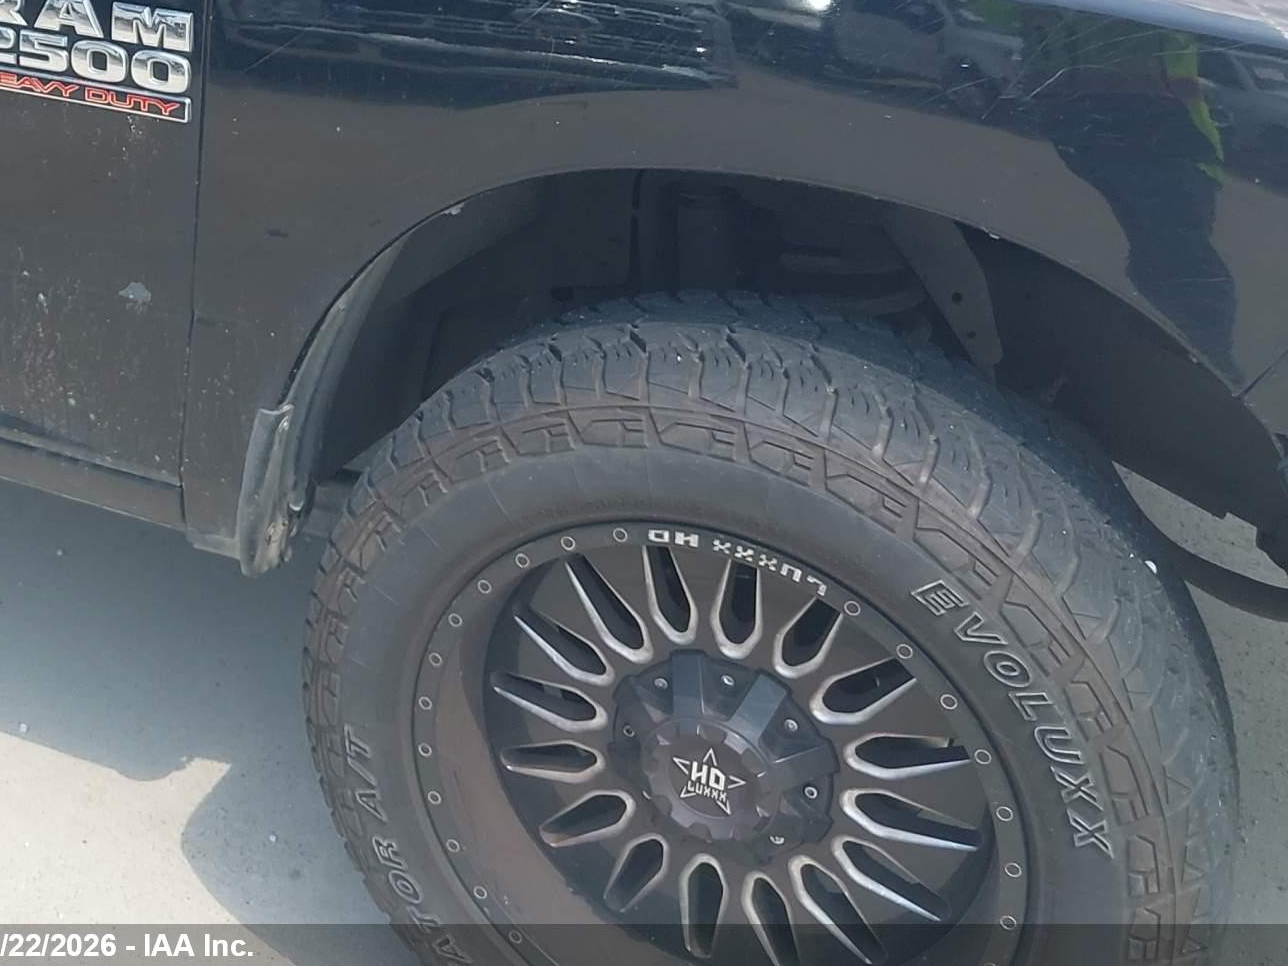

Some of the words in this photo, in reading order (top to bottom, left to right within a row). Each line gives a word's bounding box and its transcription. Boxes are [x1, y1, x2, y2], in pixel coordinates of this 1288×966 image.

[85, 87, 180, 116] DUTY
[648, 529, 699, 548] HD
[911, 579, 1114, 858] EVOLUXX
[691, 761, 726, 791] HD
[687, 780, 727, 803] LUXXX
